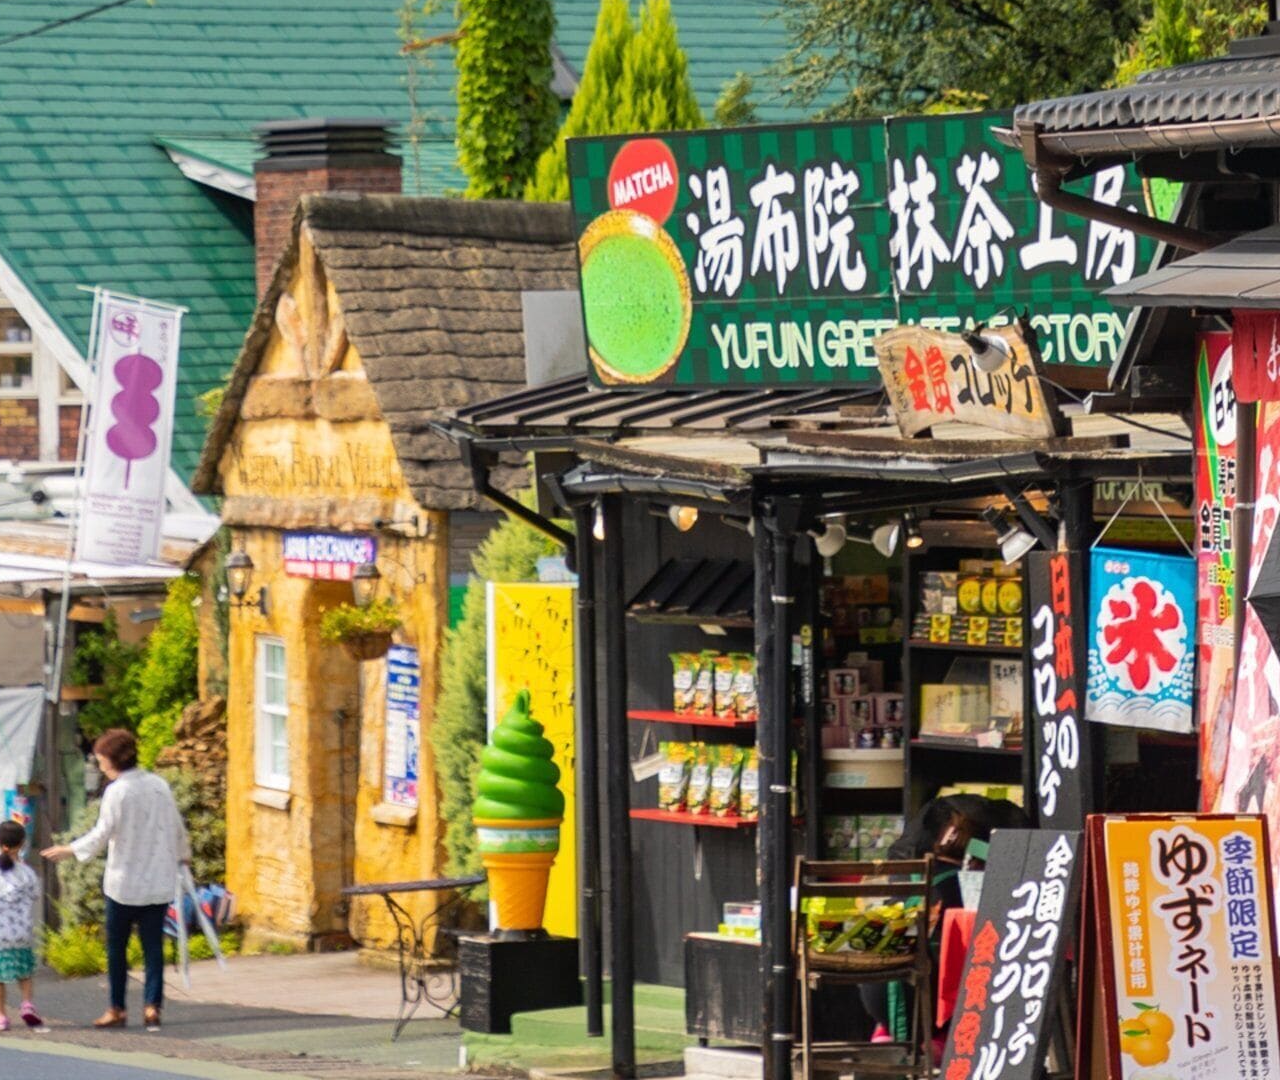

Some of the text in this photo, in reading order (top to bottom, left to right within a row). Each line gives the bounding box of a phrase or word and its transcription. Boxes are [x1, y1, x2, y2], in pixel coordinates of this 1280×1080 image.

[613, 161, 674, 206] MATCHA
[686, 158, 868, 298] 湯布院
[711, 320, 815, 370] YUFUIN
[1032, 604, 1062, 817] コロッケ
[1050, 554, 1080, 770] 日本一の
[1103, 580, 1180, 692] 氷
[973, 881, 1039, 1080] コンクール
[1008, 835, 1074, 1067] 全国コロッケ
[1157, 833, 1215, 1048] ゆずネード
[1223, 835, 1260, 959] 季節限定
